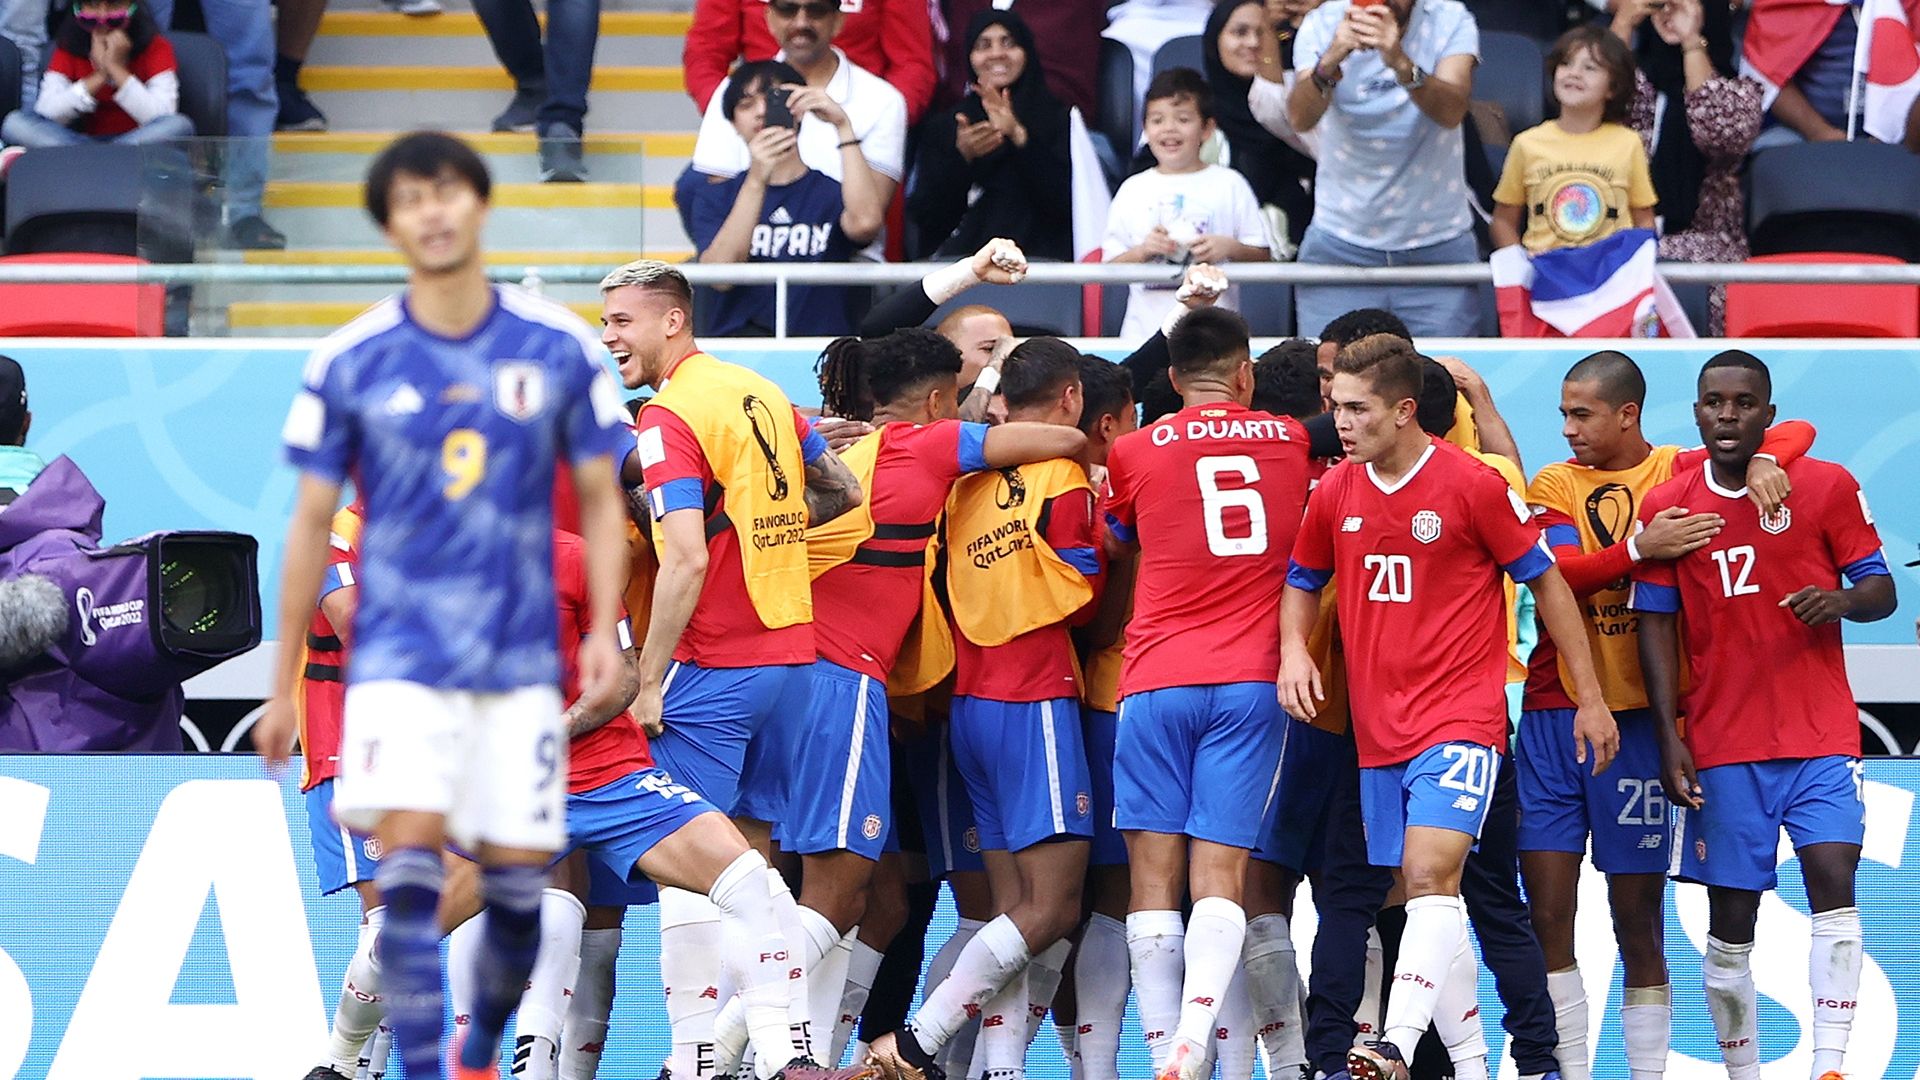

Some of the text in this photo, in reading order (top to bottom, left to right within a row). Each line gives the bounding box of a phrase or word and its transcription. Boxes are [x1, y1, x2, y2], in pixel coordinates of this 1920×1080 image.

[750, 222, 832, 257] APAN
[1151, 420, 1290, 446] O. DUARTE
[441, 428, 488, 501] 9
[1196, 454, 1269, 557] 6
[752, 528, 806, 552] Qatar202
[967, 518, 1029, 556] FIFA WORL
[974, 533, 1034, 569] Qatar2
[1363, 554, 1413, 603] 20
[1711, 545, 1760, 598] 12
[534, 731, 557, 791] 9
[1438, 744, 1489, 796] 20
[1617, 778, 1665, 826] 26
